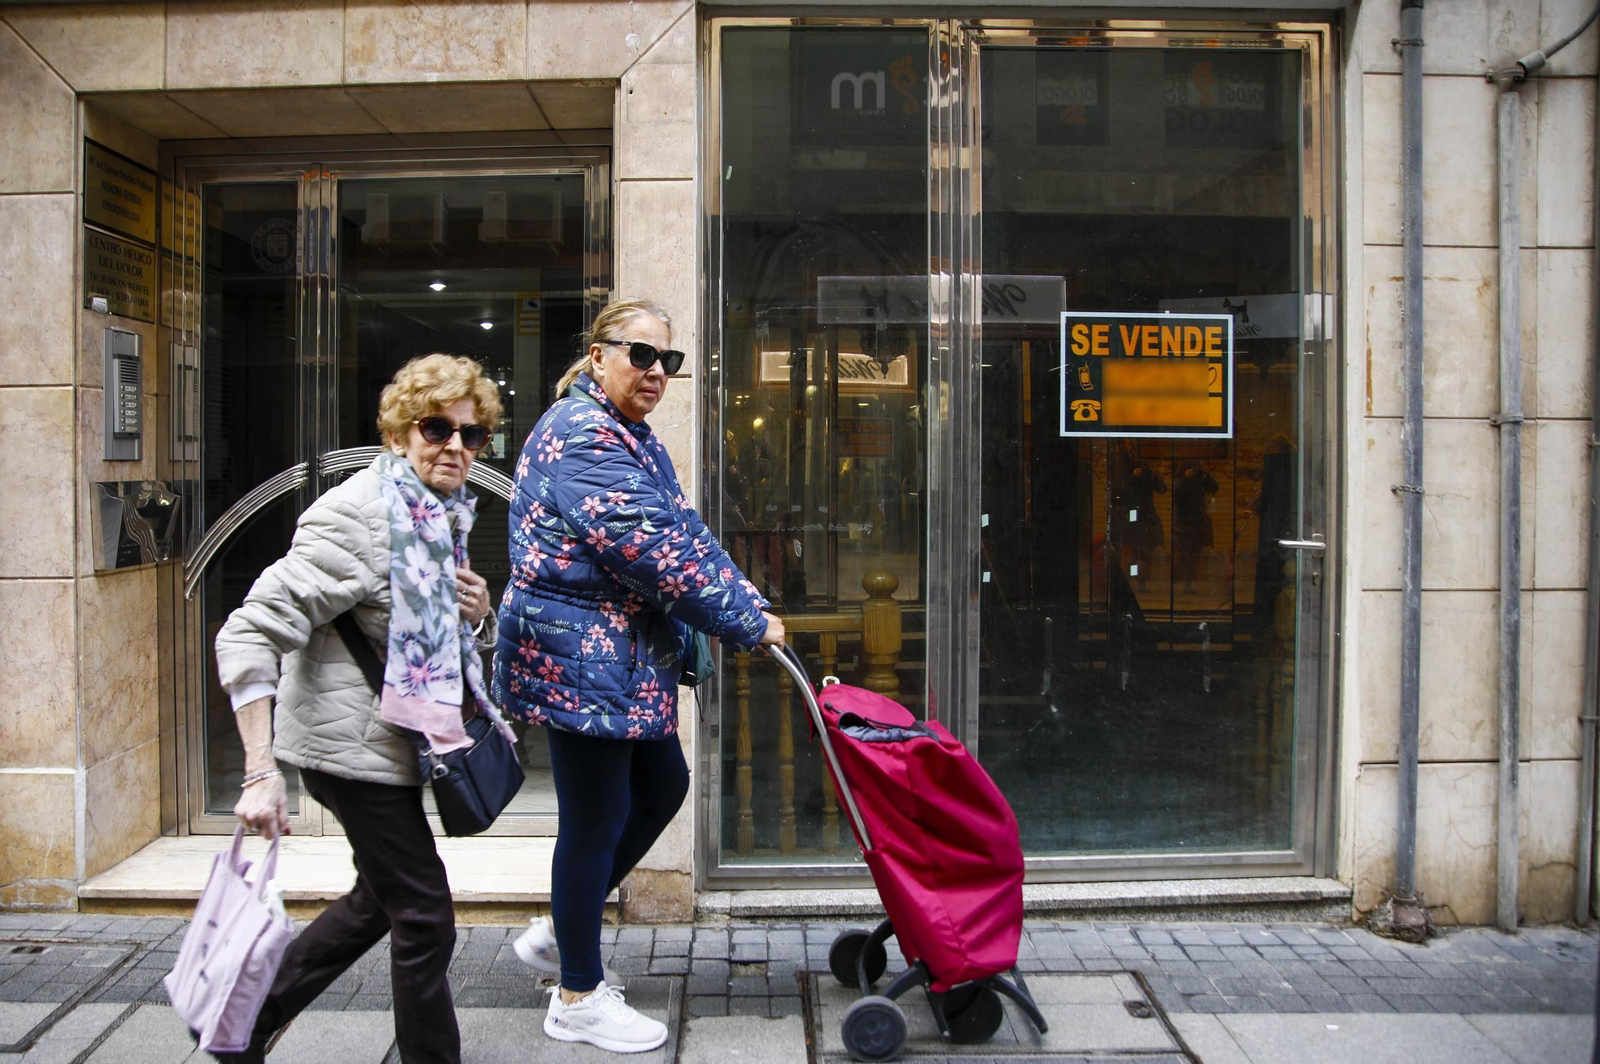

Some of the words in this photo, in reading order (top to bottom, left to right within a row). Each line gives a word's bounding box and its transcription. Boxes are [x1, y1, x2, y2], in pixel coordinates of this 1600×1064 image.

[89, 235, 122, 256] CENTRO
[98, 254, 114, 271] DEL
[116, 259, 144, 279] DOLOR
[101, 273, 127, 289] MARCOS
[1070, 323, 1110, 356] SE
[1118, 323, 1223, 358] VENDE
